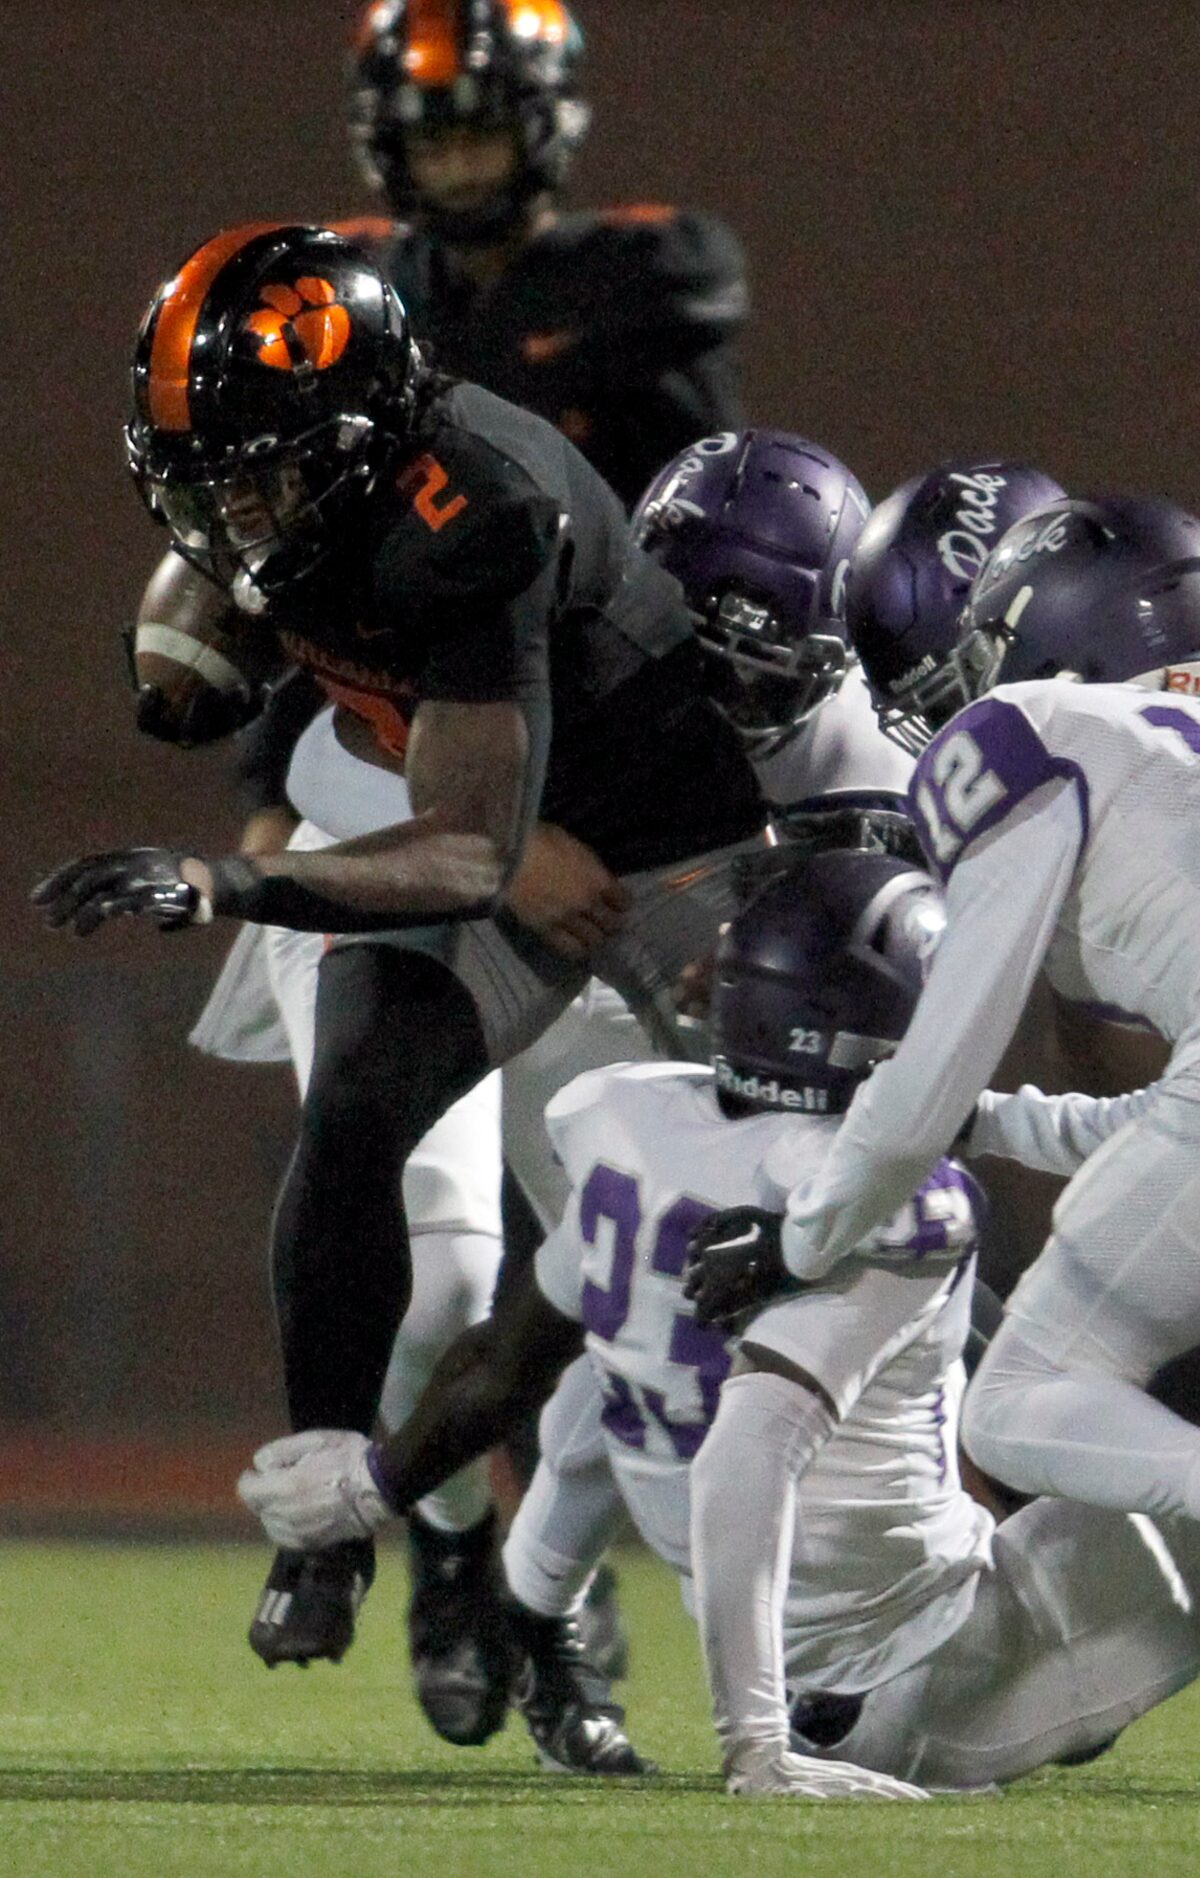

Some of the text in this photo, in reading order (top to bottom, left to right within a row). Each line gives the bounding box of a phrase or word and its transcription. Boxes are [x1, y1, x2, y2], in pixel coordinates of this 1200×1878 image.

[396, 453, 468, 532] 2
[917, 729, 1008, 863] 12
[788, 1028, 821, 1054] 23
